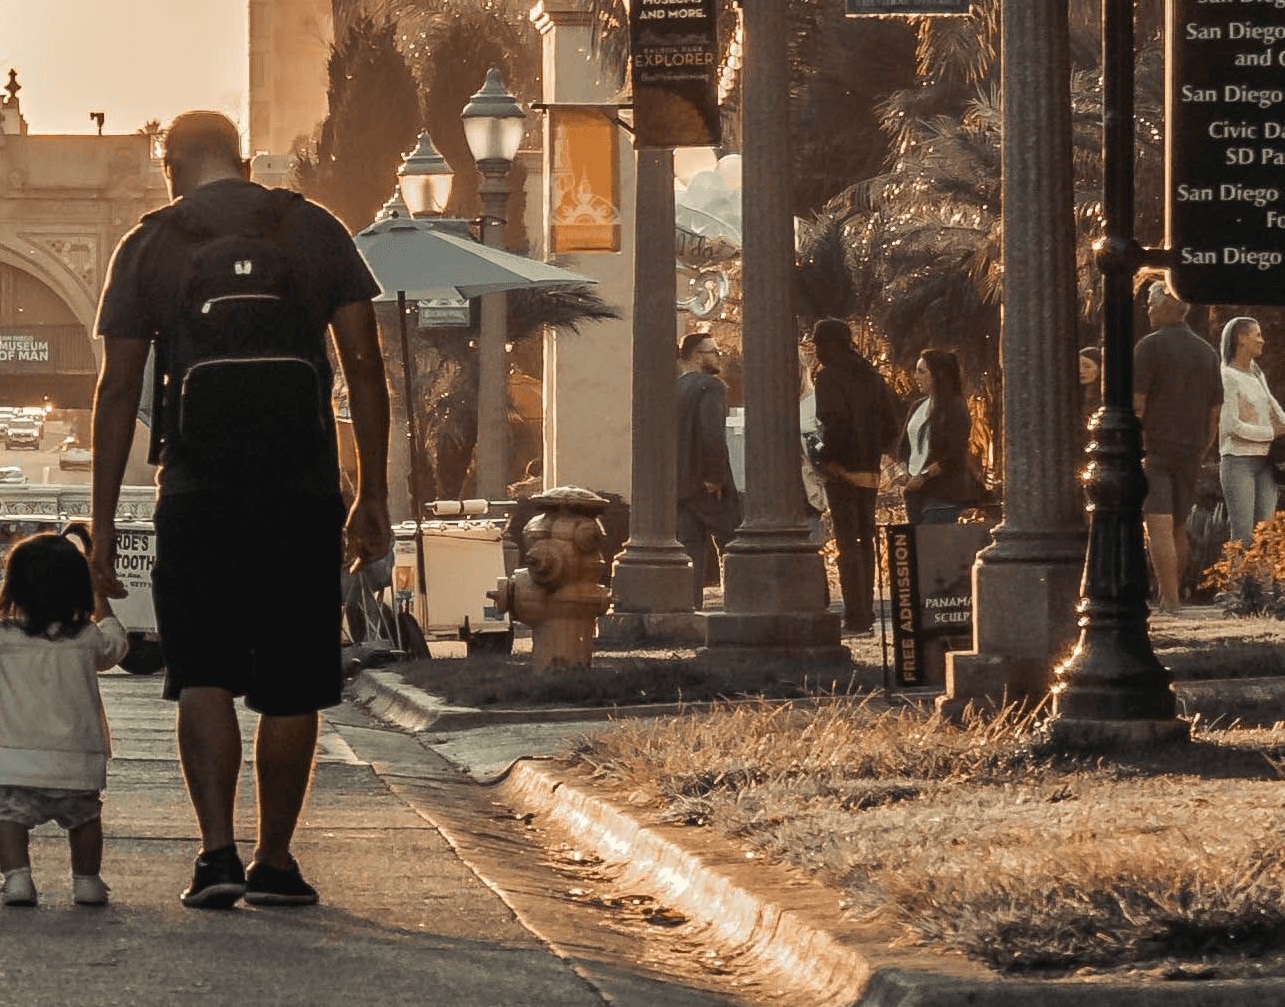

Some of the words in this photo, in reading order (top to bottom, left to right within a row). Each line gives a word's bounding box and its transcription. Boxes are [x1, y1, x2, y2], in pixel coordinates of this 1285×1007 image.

[639, 10, 665, 20] AND
[668, 8, 707, 19] MORE.
[1186, 22, 1221, 40] San
[1229, 21, 1285, 45] Diego
[635, 53, 714, 67] EXPLORER
[1234, 48, 1272, 66] and
[1182, 85, 1217, 102] San
[1224, 83, 1283, 109] Diego
[1209, 121, 1258, 139] Civic
[1226, 148, 1254, 165] SD
[1261, 148, 1285, 165] Pa
[1177, 184, 1213, 201] San
[1220, 183, 1279, 207] Diego
[1181, 247, 1217, 264] San
[1223, 247, 1282, 271] Diego
[18, 351, 48, 361] MAN
[116, 535, 149, 551] RDE'S
[895, 534, 914, 633] ADMISSION
[902, 638, 915, 682] FREE
